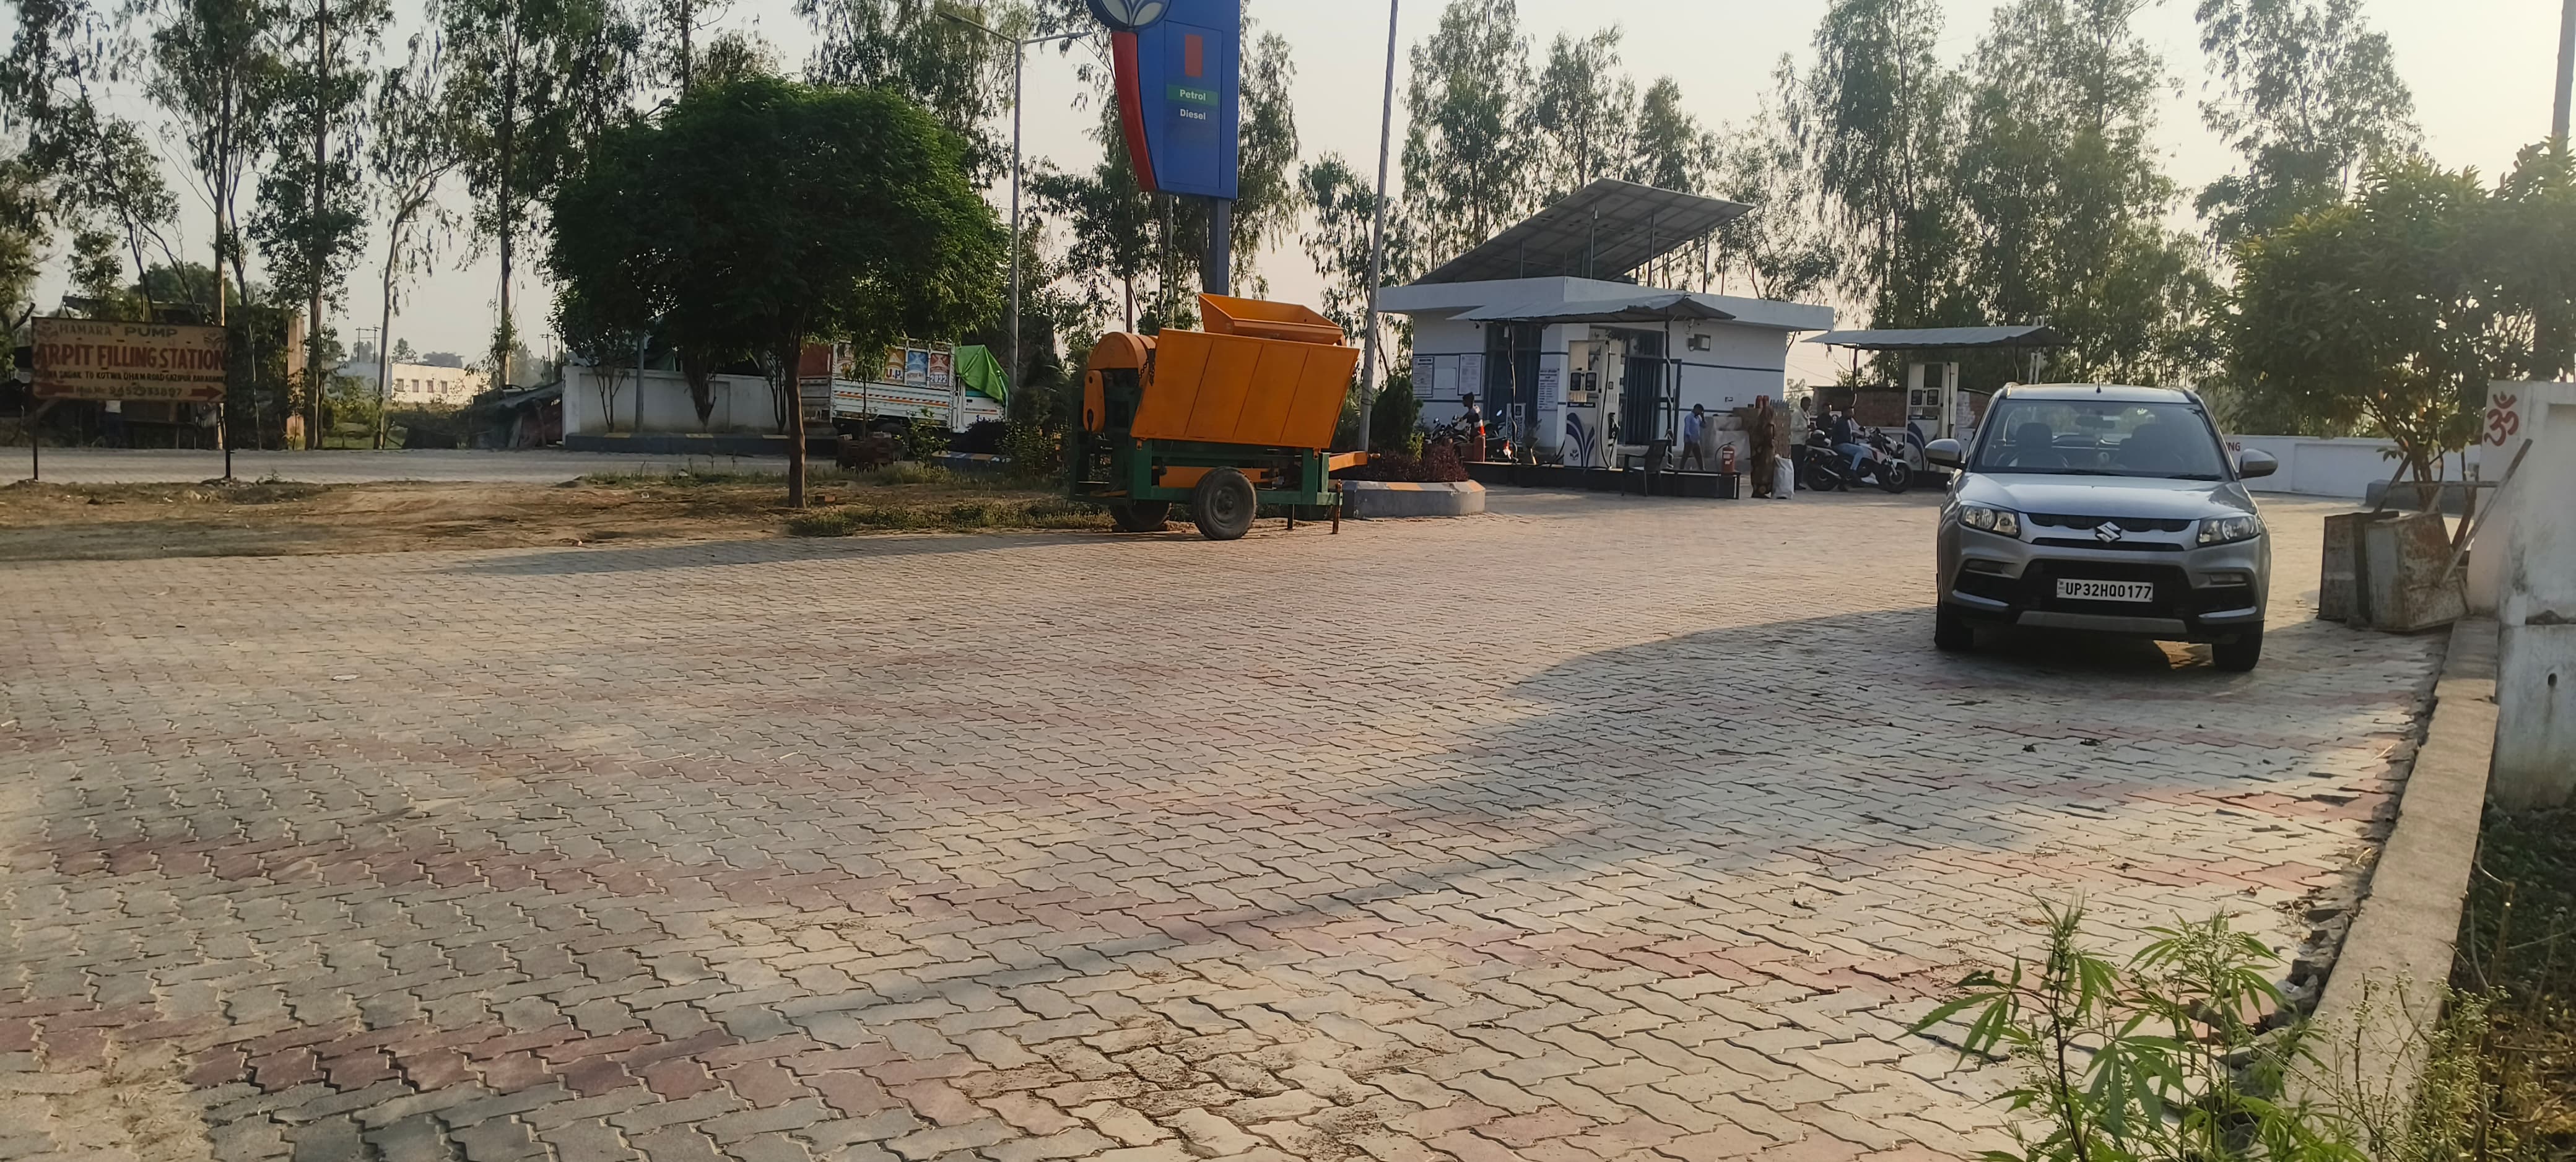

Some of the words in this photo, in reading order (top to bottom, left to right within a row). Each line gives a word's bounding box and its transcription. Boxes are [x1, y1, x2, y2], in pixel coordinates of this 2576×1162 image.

[1180, 89, 1206, 101] Petrol
[1180, 108, 1206, 120] Diesel
[59, 324, 112, 336] HAMARA
[124, 327, 178, 337] PUMP
[34, 343, 94, 366] ARPIT
[97, 345, 157, 368] FILLING
[159, 348, 227, 371] STATION
[85, 371, 94, 379] TO
[930, 375, 947, 383] 2022
[2066, 582, 2152, 599] UP32HQ0177
